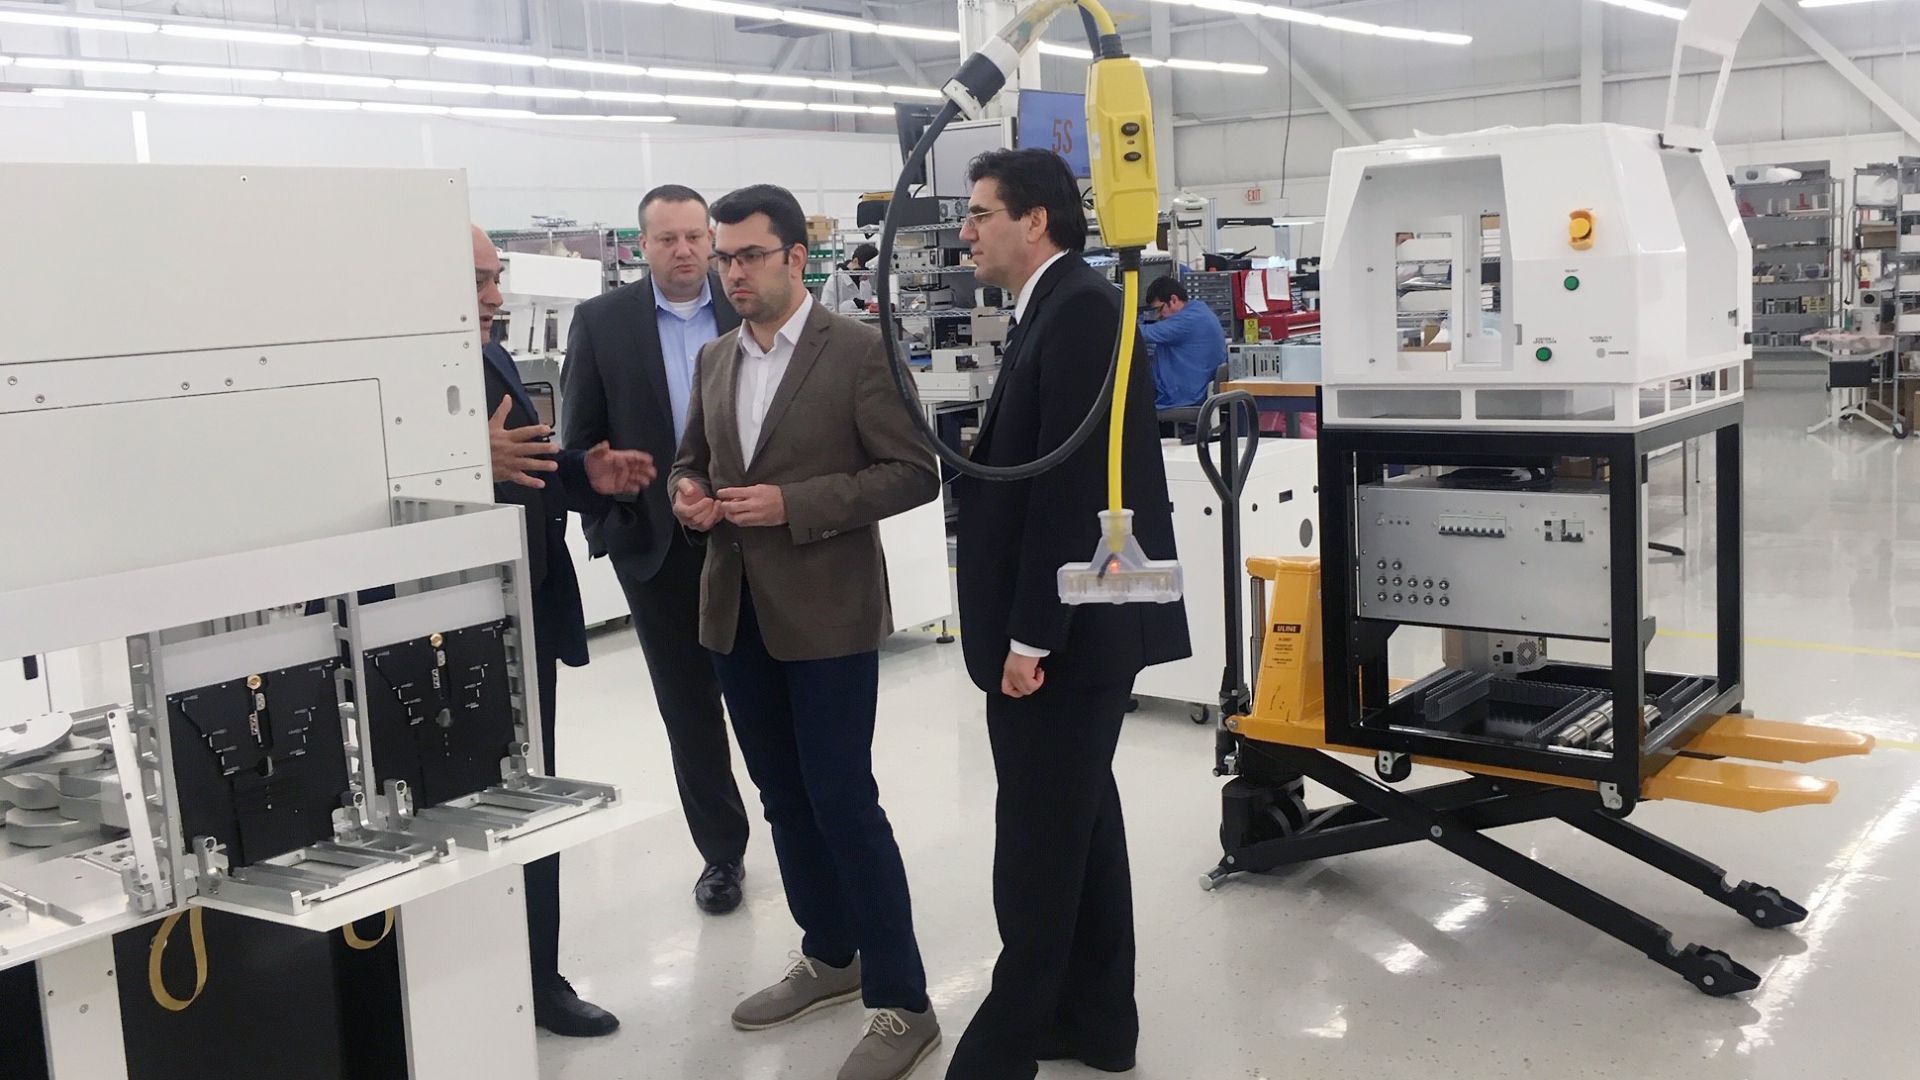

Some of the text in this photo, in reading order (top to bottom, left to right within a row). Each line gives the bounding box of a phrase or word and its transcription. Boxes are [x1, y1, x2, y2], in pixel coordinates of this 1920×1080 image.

[1051, 118, 1073, 155] 5S
[1247, 189, 1261, 202] EXIT
[1277, 625, 1298, 633] ULINE
